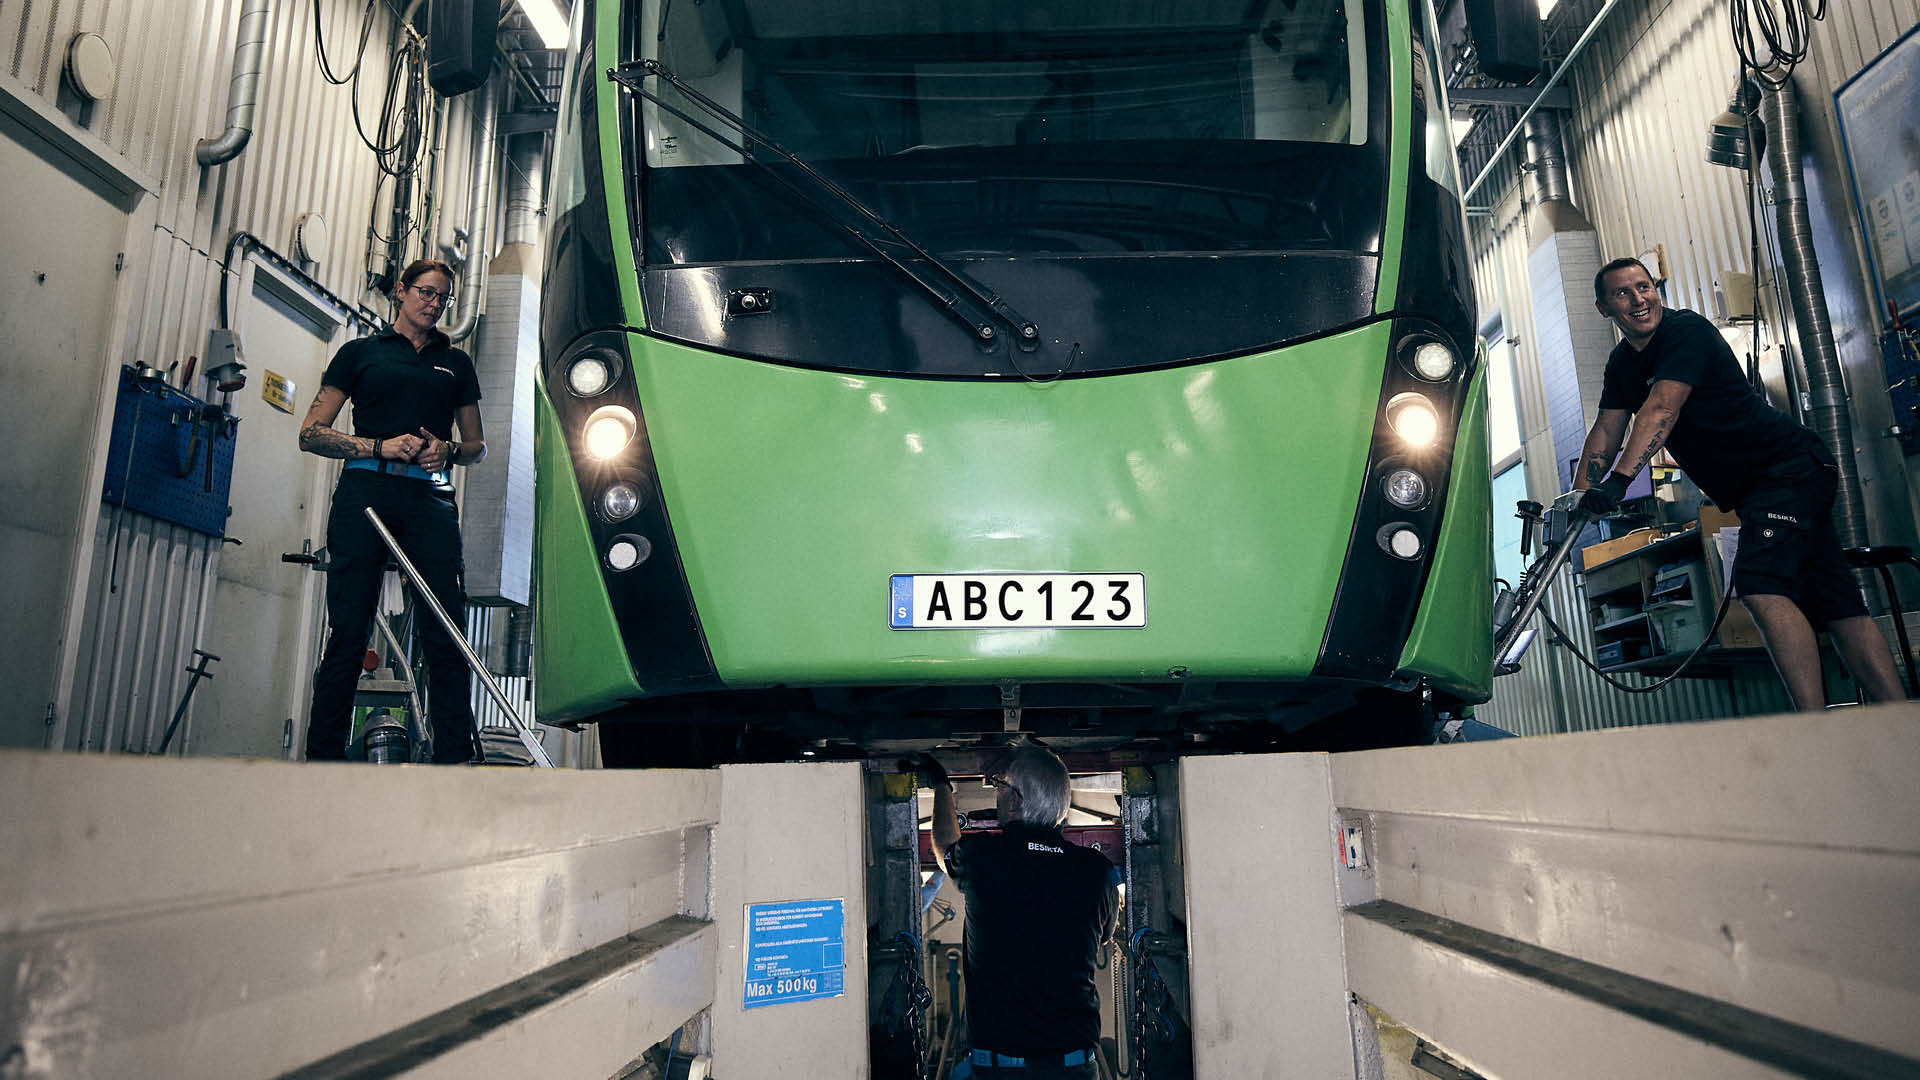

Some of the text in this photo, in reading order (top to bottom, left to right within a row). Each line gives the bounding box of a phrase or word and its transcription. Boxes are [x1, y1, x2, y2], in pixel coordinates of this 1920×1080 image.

[898, 580, 1132, 622] S ABC123
[1028, 842, 1064, 854] BESIKTA
[747, 982, 773, 998] Max
